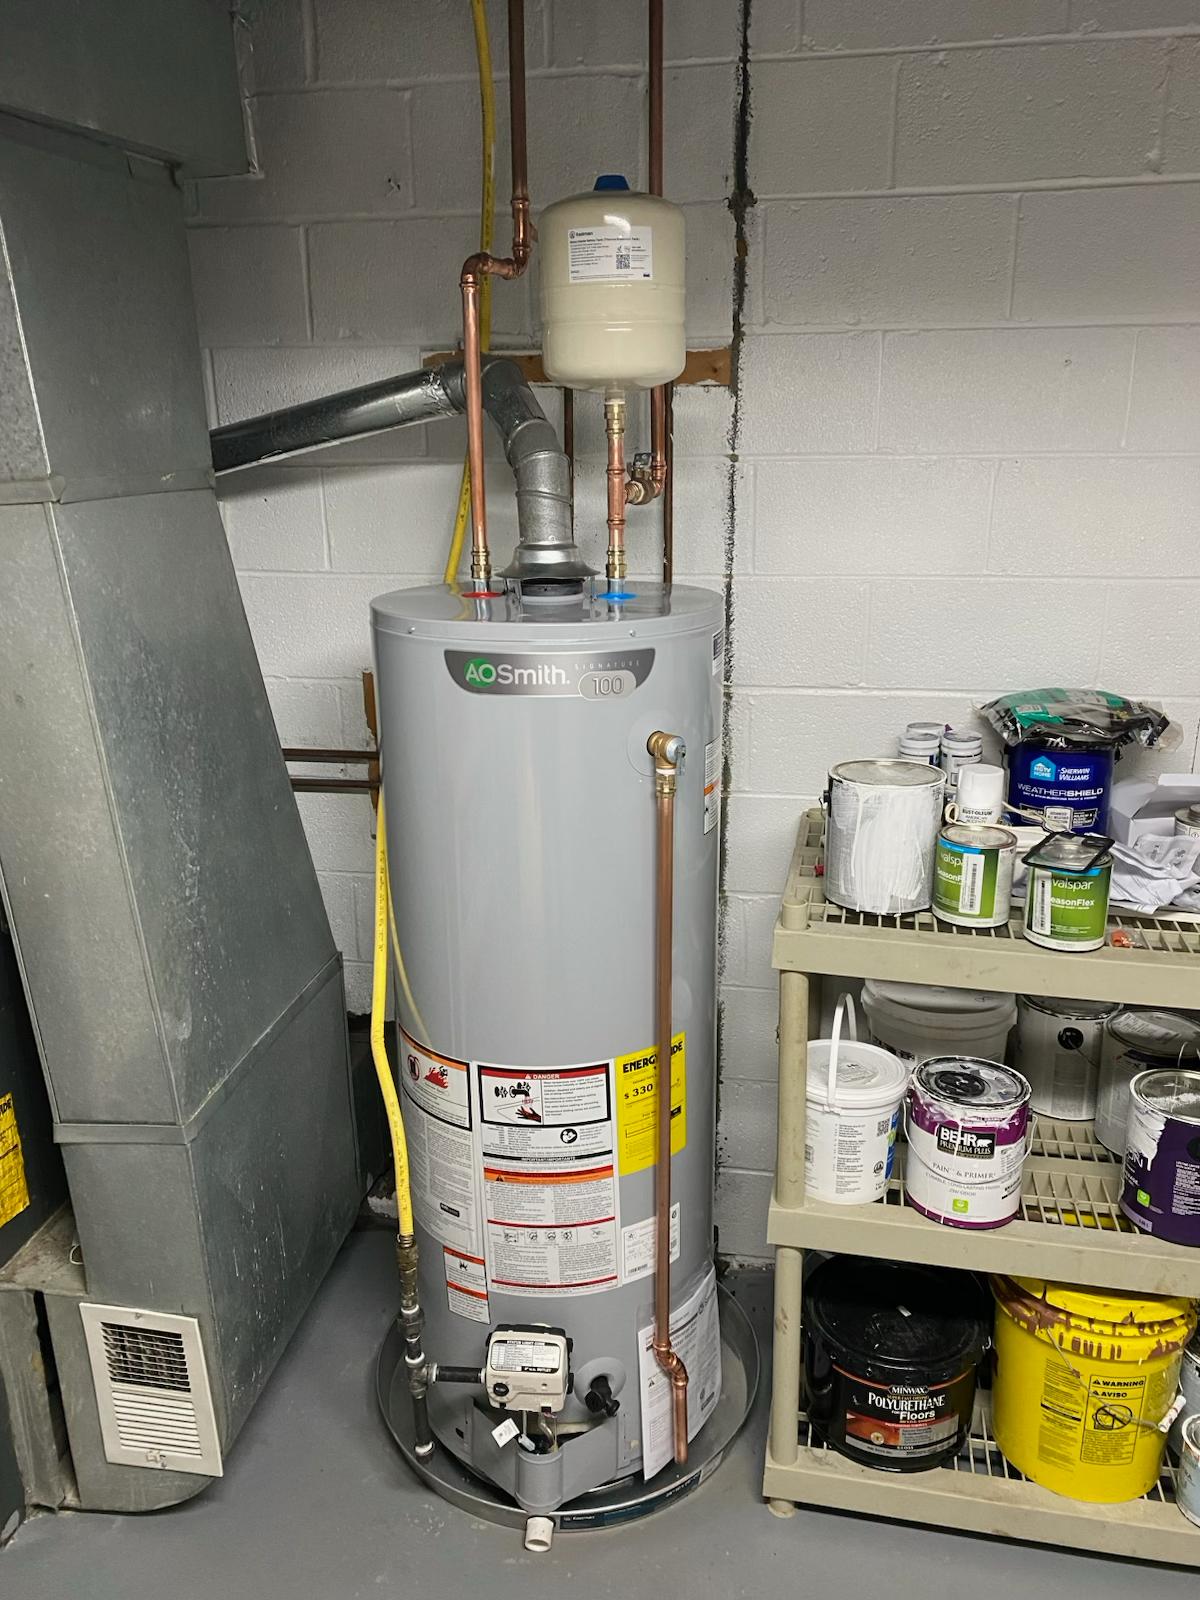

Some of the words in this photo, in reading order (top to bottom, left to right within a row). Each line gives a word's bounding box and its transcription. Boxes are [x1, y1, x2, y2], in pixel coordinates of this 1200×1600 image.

[574, 659, 640, 670] SIGNATURE
[592, 675, 625, 696] 100
[1017, 782, 1104, 798] WEATHERSHIELD
[1052, 877, 1094, 892] valspar
[1050, 896, 1095, 907] easonFlex
[632, 1083, 653, 1098] 330
[940, 1126, 978, 1147] BEHR
[974, 1146, 991, 1155] PLUS
[868, 1391, 946, 1412] POLYURETHANE
[900, 1409, 936, 1421] Floors
